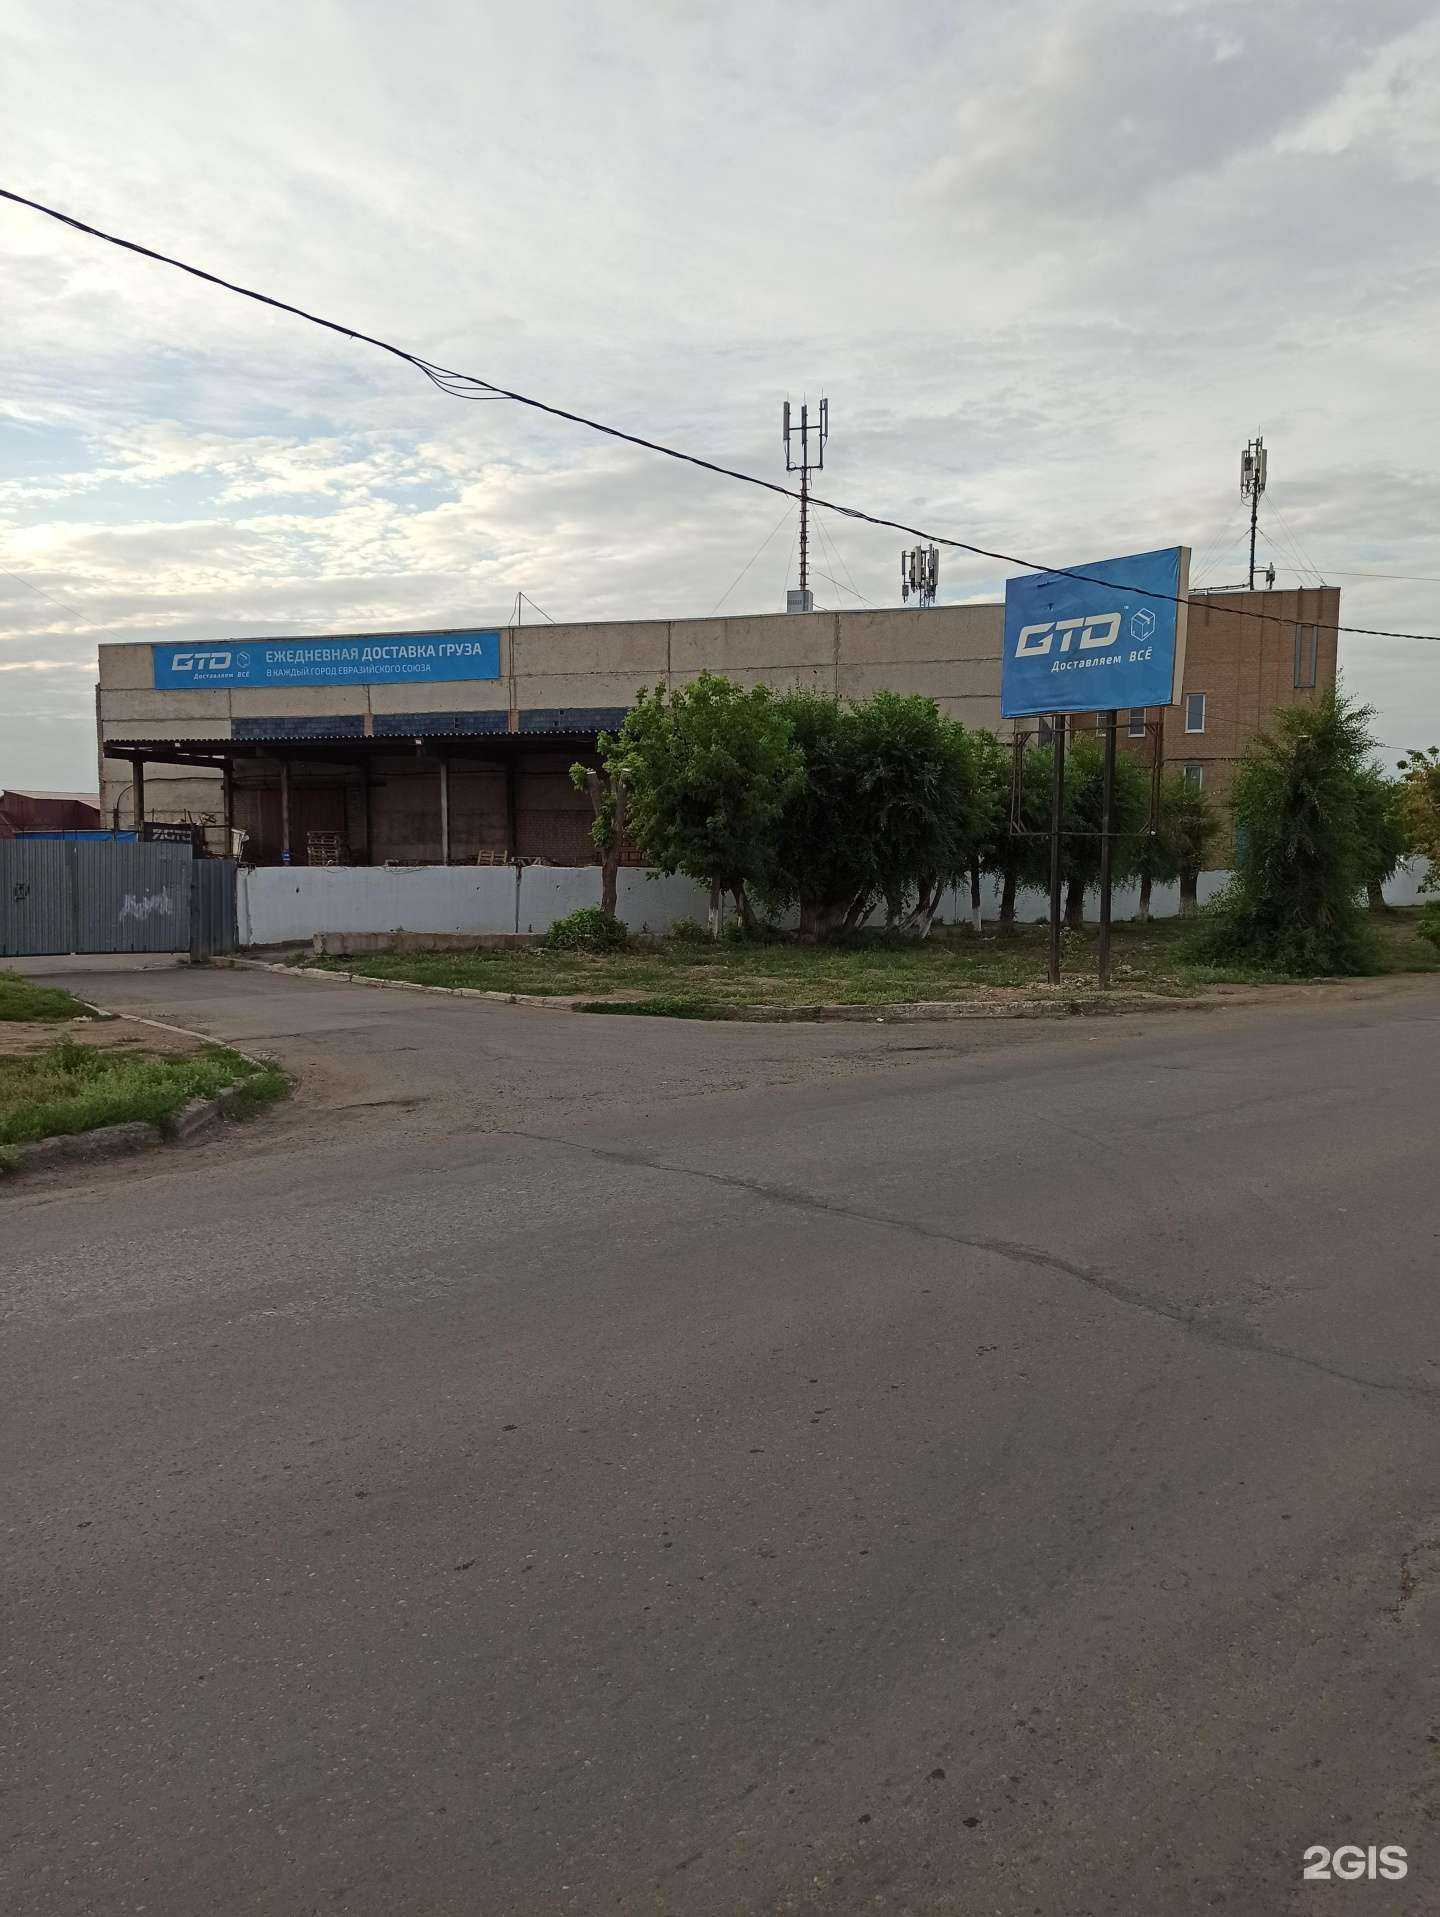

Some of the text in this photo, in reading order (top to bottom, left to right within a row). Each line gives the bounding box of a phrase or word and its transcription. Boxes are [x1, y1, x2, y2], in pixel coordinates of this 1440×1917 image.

[1015, 612, 1122, 658] GTD
[171, 651, 232, 671] GTD
[265, 642, 482, 664] ЕЖЕДНЕВНАЯ ДОСТАВКА ГРУЗА
[1051, 646, 1153, 673] Доставляем ВСЁ
[266, 663, 432, 677] В КАЖДЫЙ ГОРОД ЕВРАЗИЙСКОГО СОЮЗА
